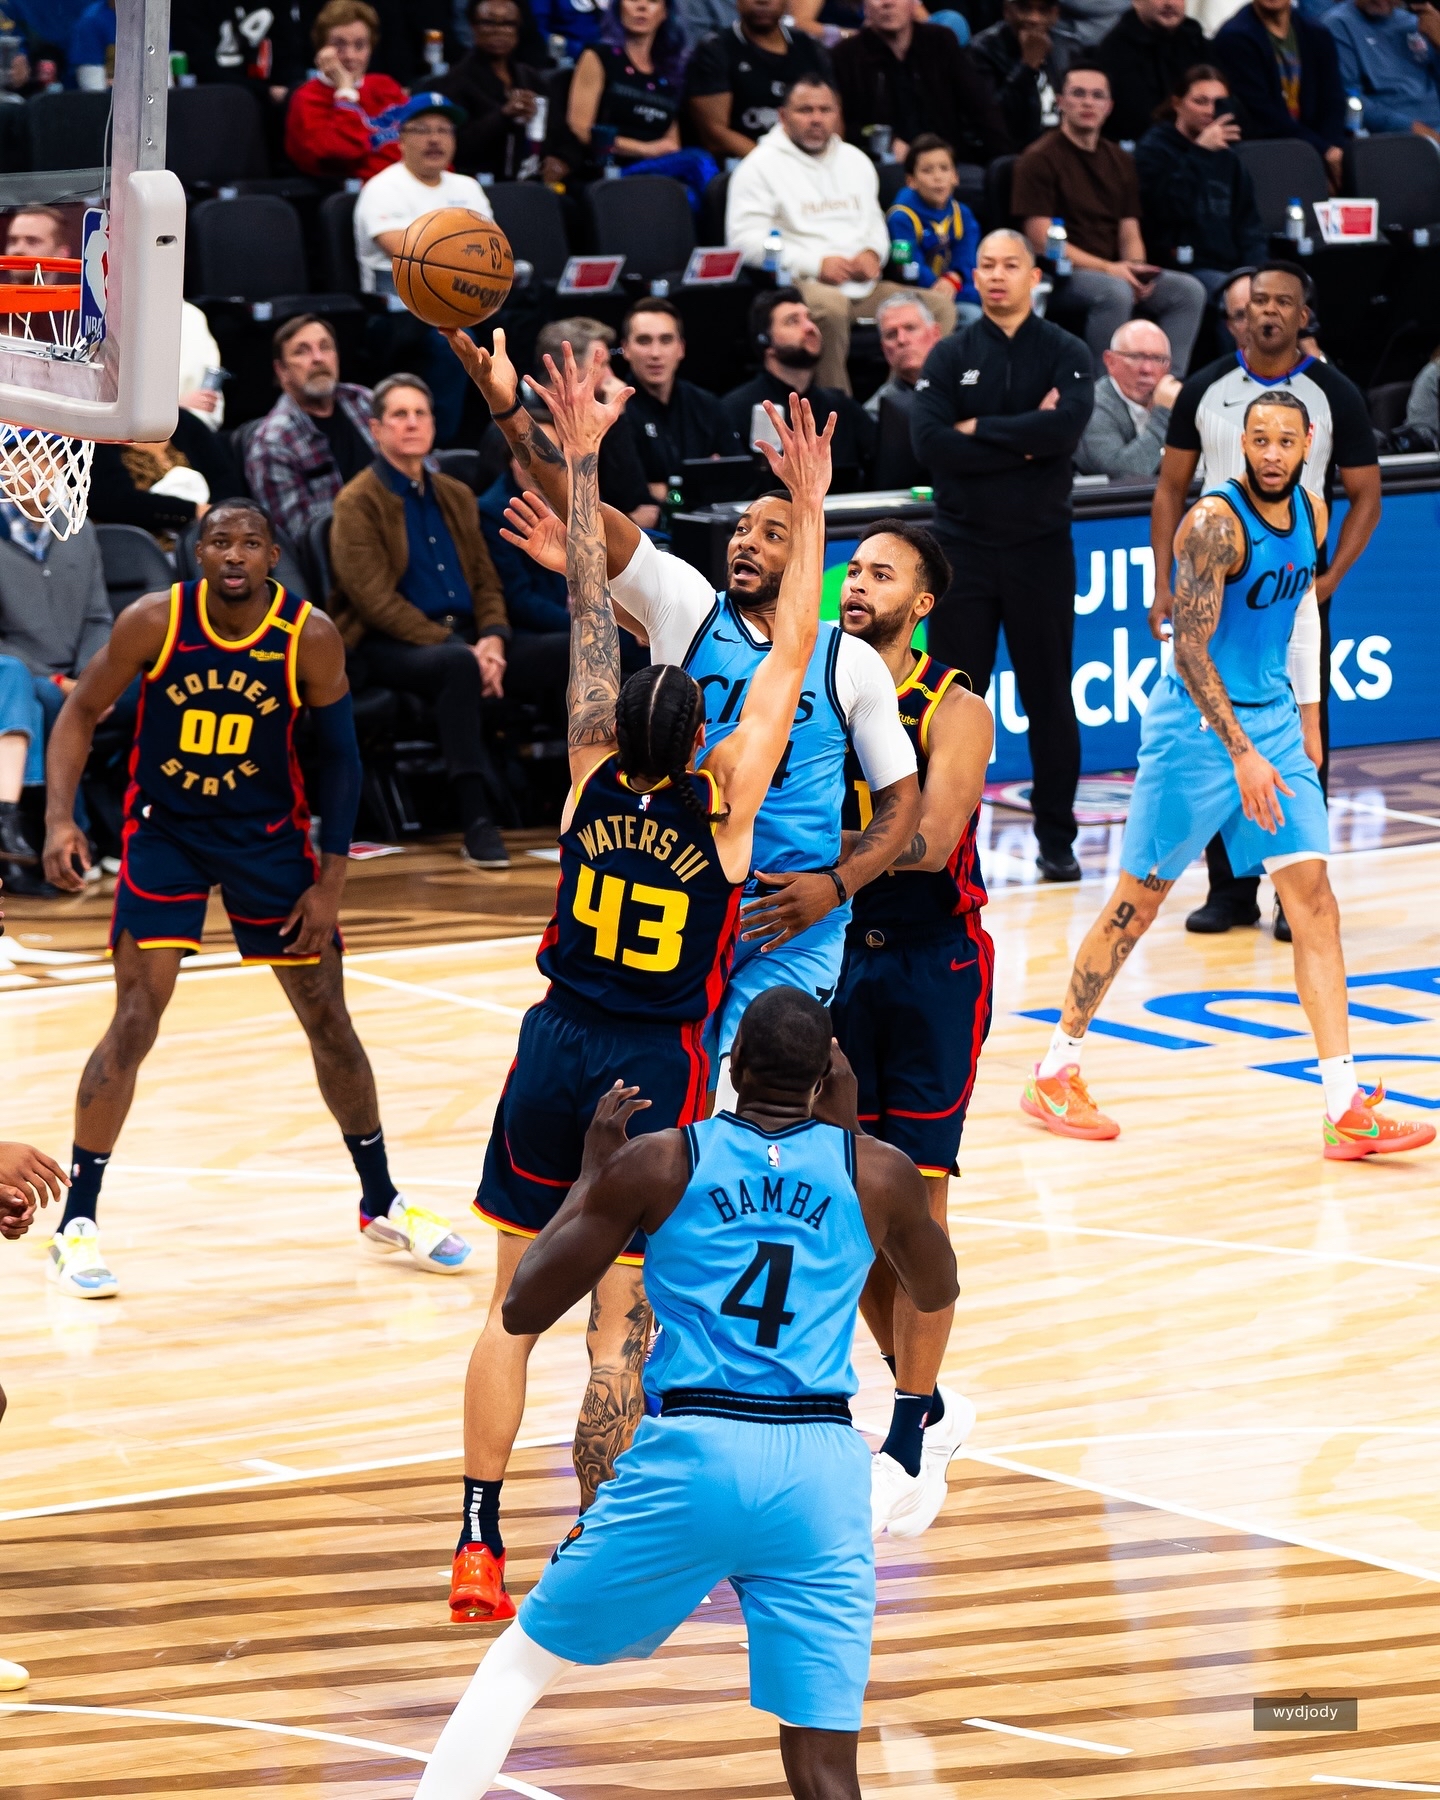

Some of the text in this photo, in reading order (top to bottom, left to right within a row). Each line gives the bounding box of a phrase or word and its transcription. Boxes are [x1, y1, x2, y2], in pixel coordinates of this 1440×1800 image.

[85, 315, 103, 339] NBA
[165, 669, 280, 716] GOLDEN
[179, 709, 254, 755] 00
[160, 757, 260, 796] STATE
[577, 815, 710, 884] WATERS III
[572, 863, 690, 972] 43
[708, 1175, 832, 1231] BAMBA
[720, 1240, 796, 1349] 4
